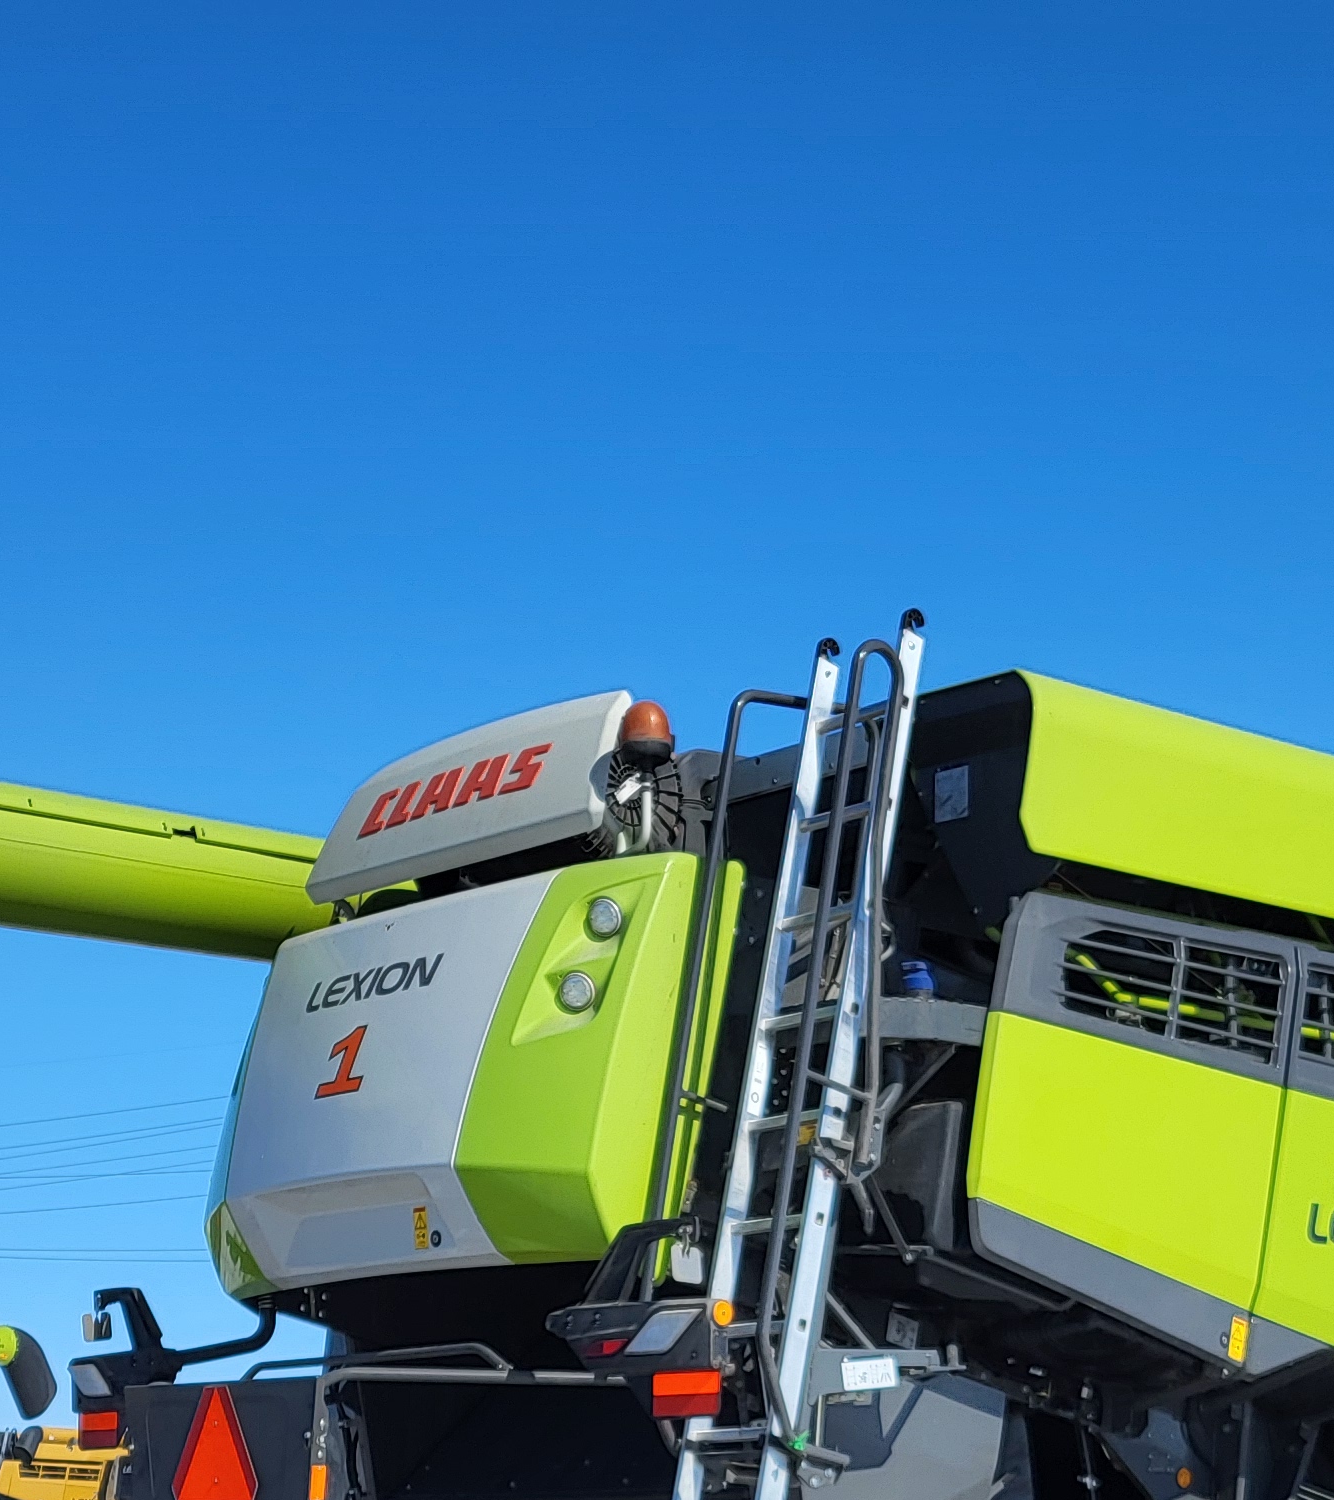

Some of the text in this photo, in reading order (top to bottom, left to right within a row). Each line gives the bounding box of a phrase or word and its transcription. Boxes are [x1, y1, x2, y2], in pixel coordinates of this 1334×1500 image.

[357, 742, 554, 840] CLAAS
[305, 952, 445, 1014] LEXION
[314, 1024, 369, 1100] 1
